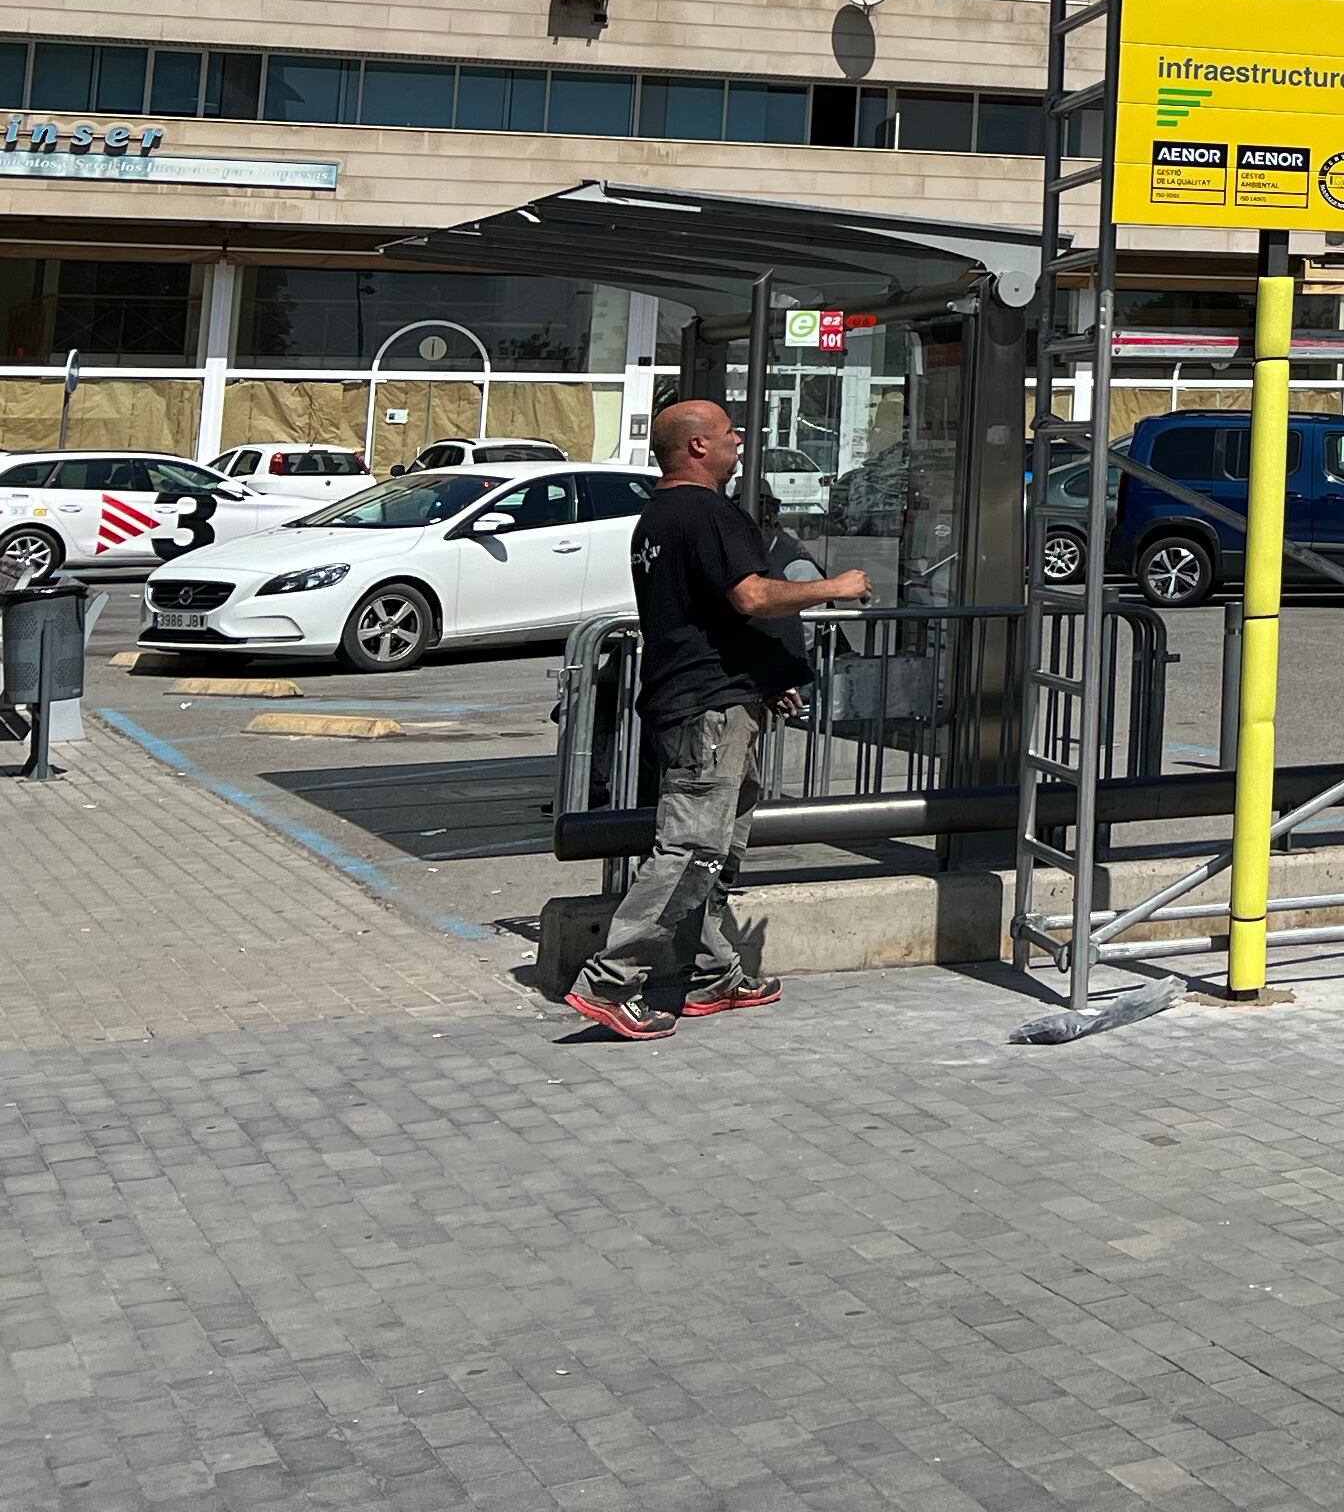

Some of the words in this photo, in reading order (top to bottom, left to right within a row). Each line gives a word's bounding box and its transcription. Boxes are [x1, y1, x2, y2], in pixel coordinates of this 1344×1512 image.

[1157, 146, 1221, 164] AENOR
[1241, 151, 1304, 167] AENOR
[822, 333, 842, 348] 101
[159, 614, 182, 627] 3986
